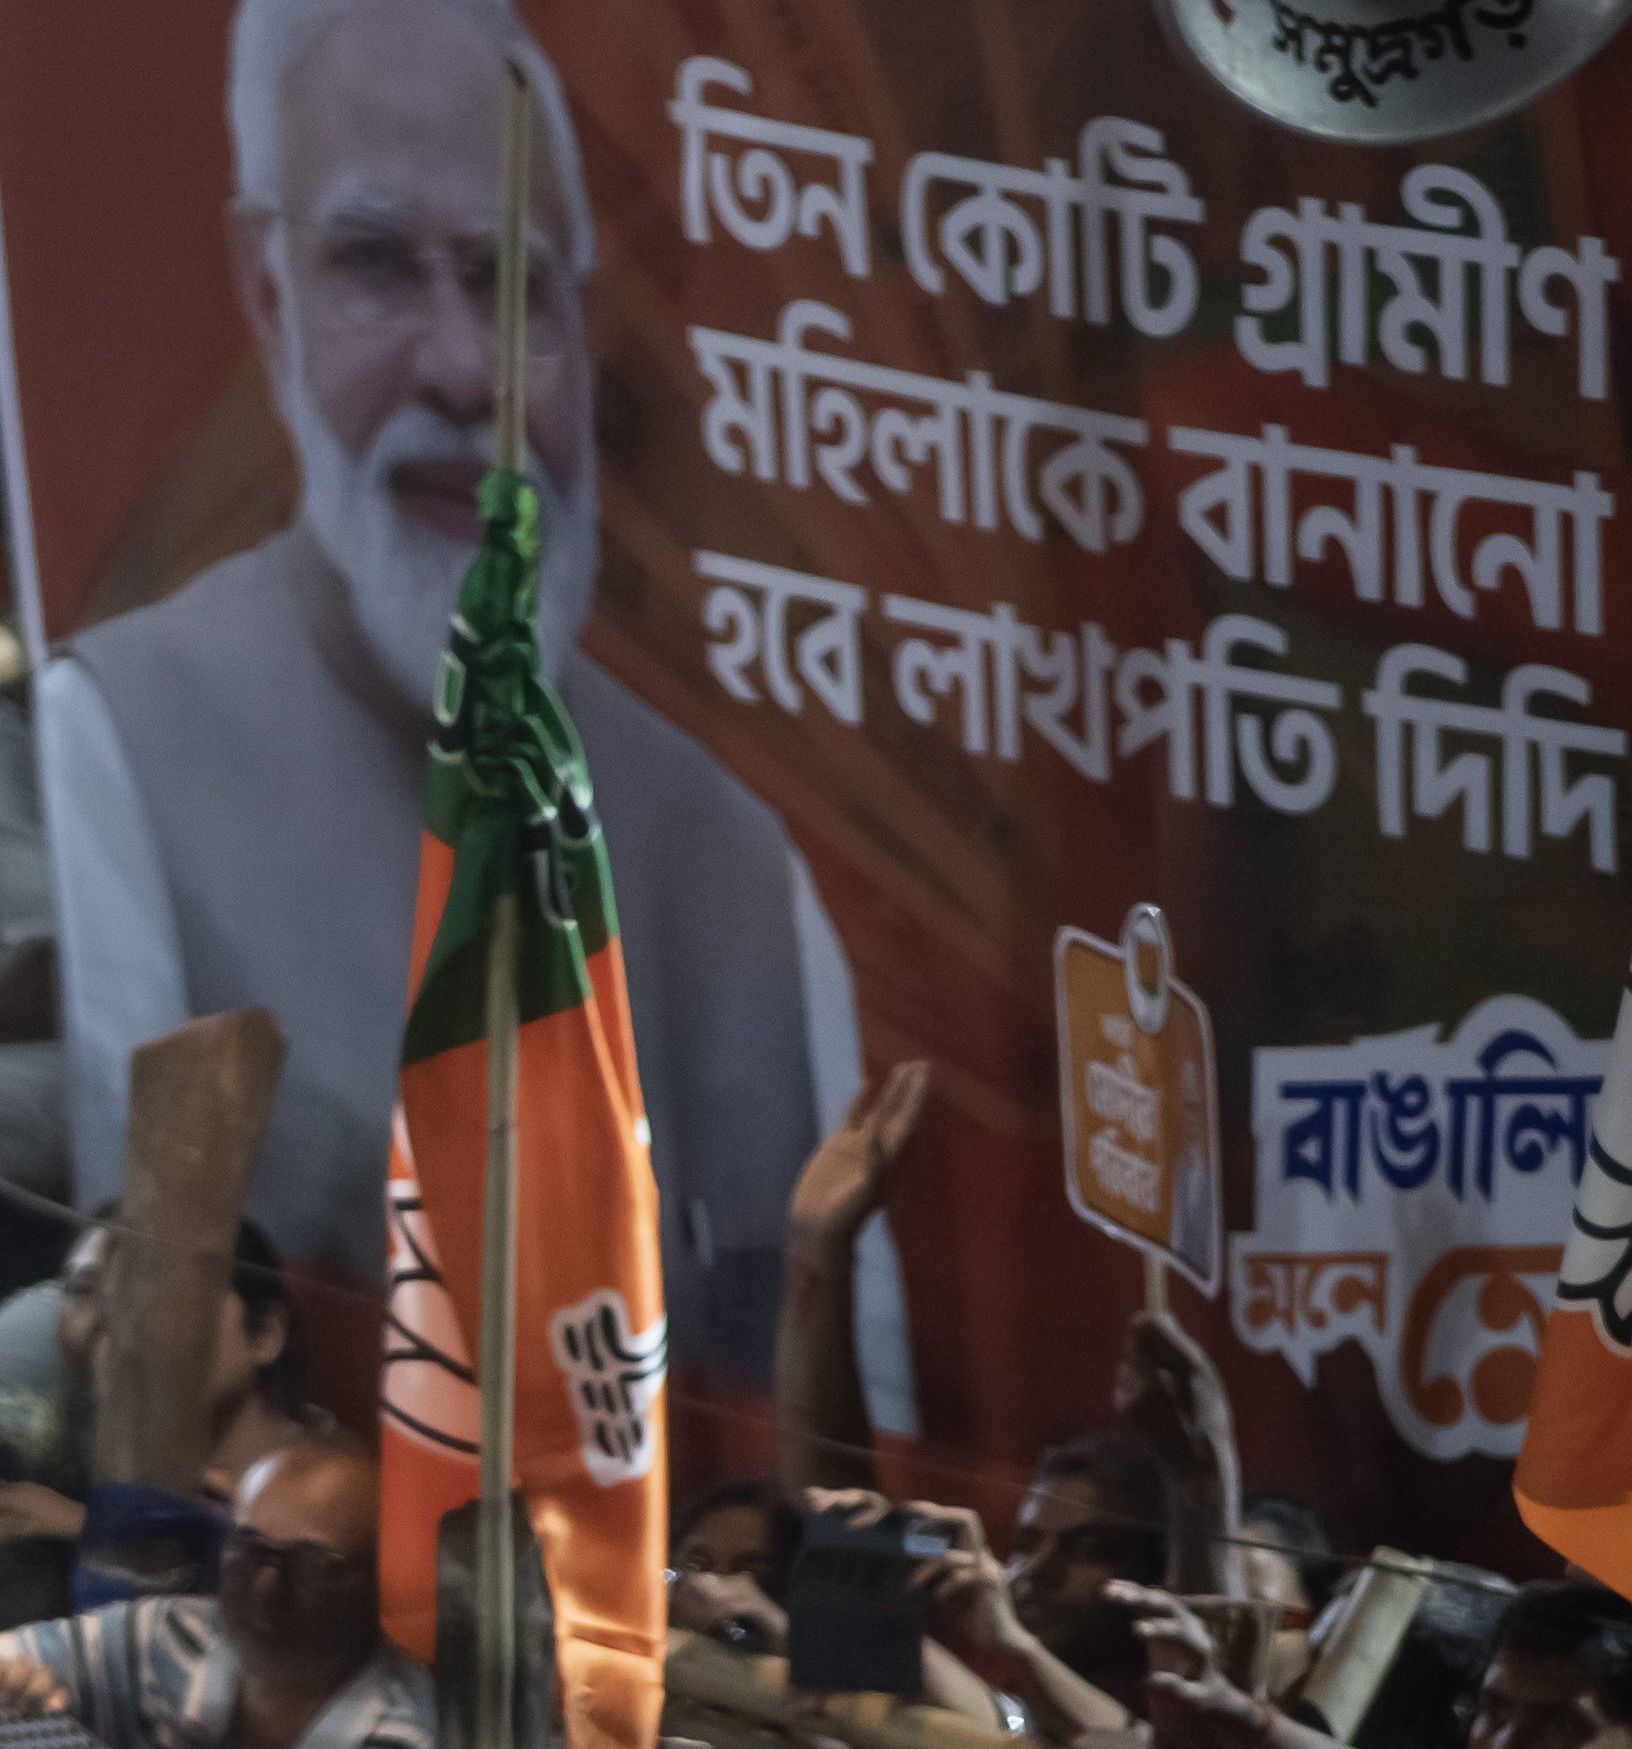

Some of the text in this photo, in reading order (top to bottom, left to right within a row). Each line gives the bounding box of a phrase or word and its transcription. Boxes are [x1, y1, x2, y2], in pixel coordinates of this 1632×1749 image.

[670, 58, 1616, 398] তিন কোটি গ্রামীণ
[691, 301, 1611, 633] মহিলাকে বানানো
[695, 552, 1625, 869] হবে লাখপতি দিদি
[1281, 1027, 1604, 1201] বাঙালি
[1244, 1251, 1391, 1336] মনে
